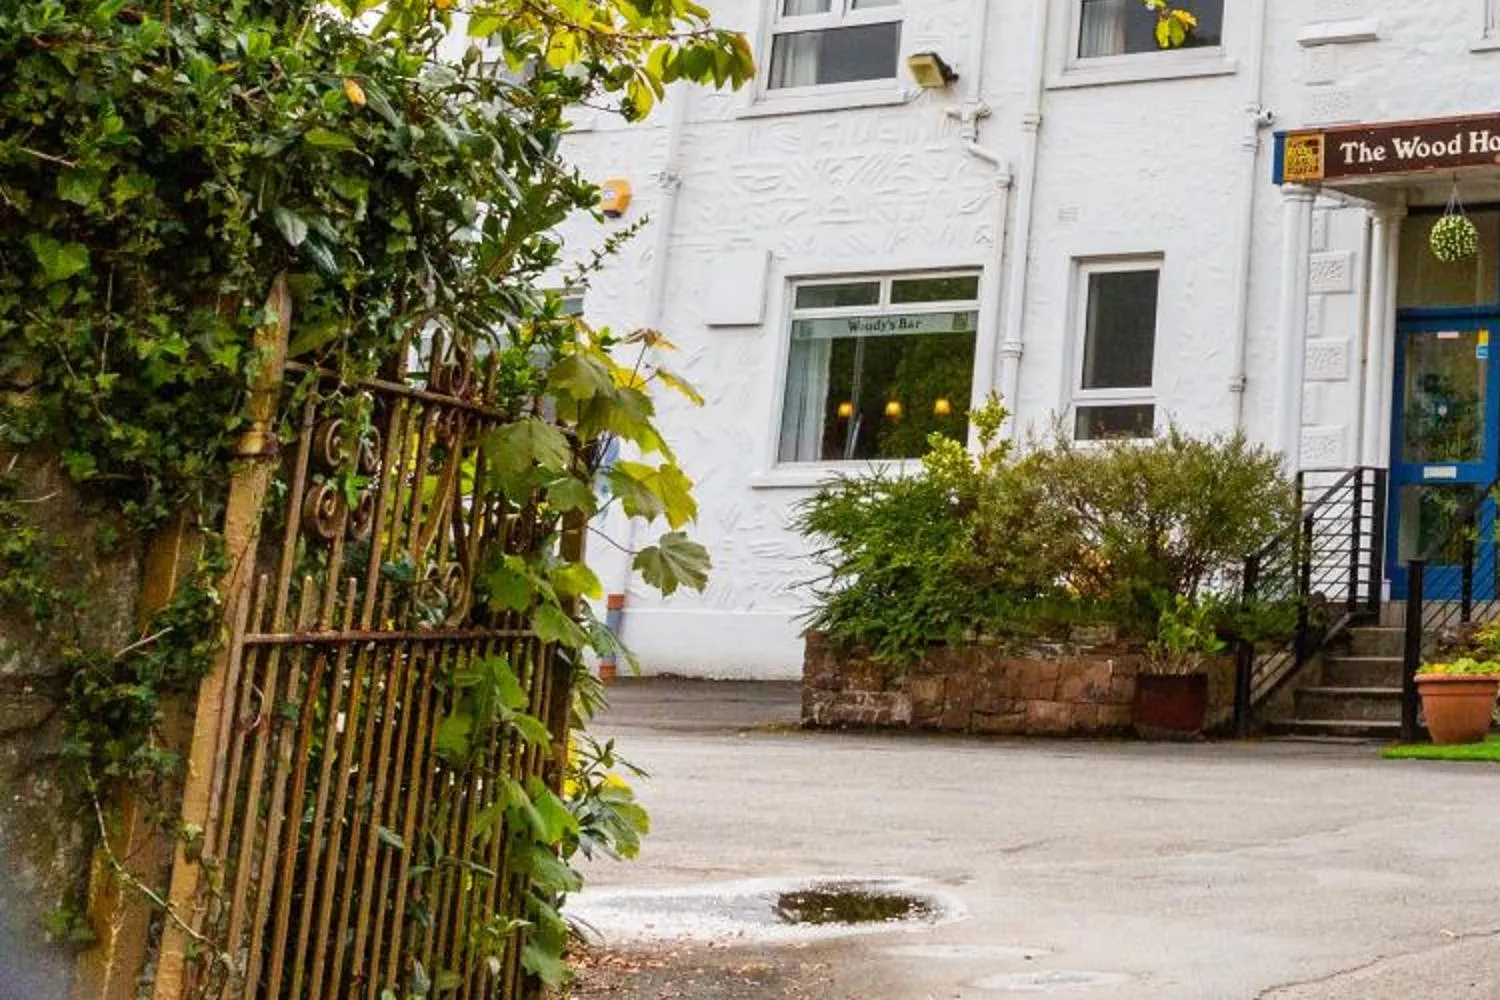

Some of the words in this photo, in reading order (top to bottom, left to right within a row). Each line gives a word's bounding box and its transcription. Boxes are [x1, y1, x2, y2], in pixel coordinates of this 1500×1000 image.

[1340, 141, 1386, 165] The
[1393, 133, 1462, 159] Wood
[848, 319, 896, 332] Wody's
[899, 318, 922, 329] Bar
